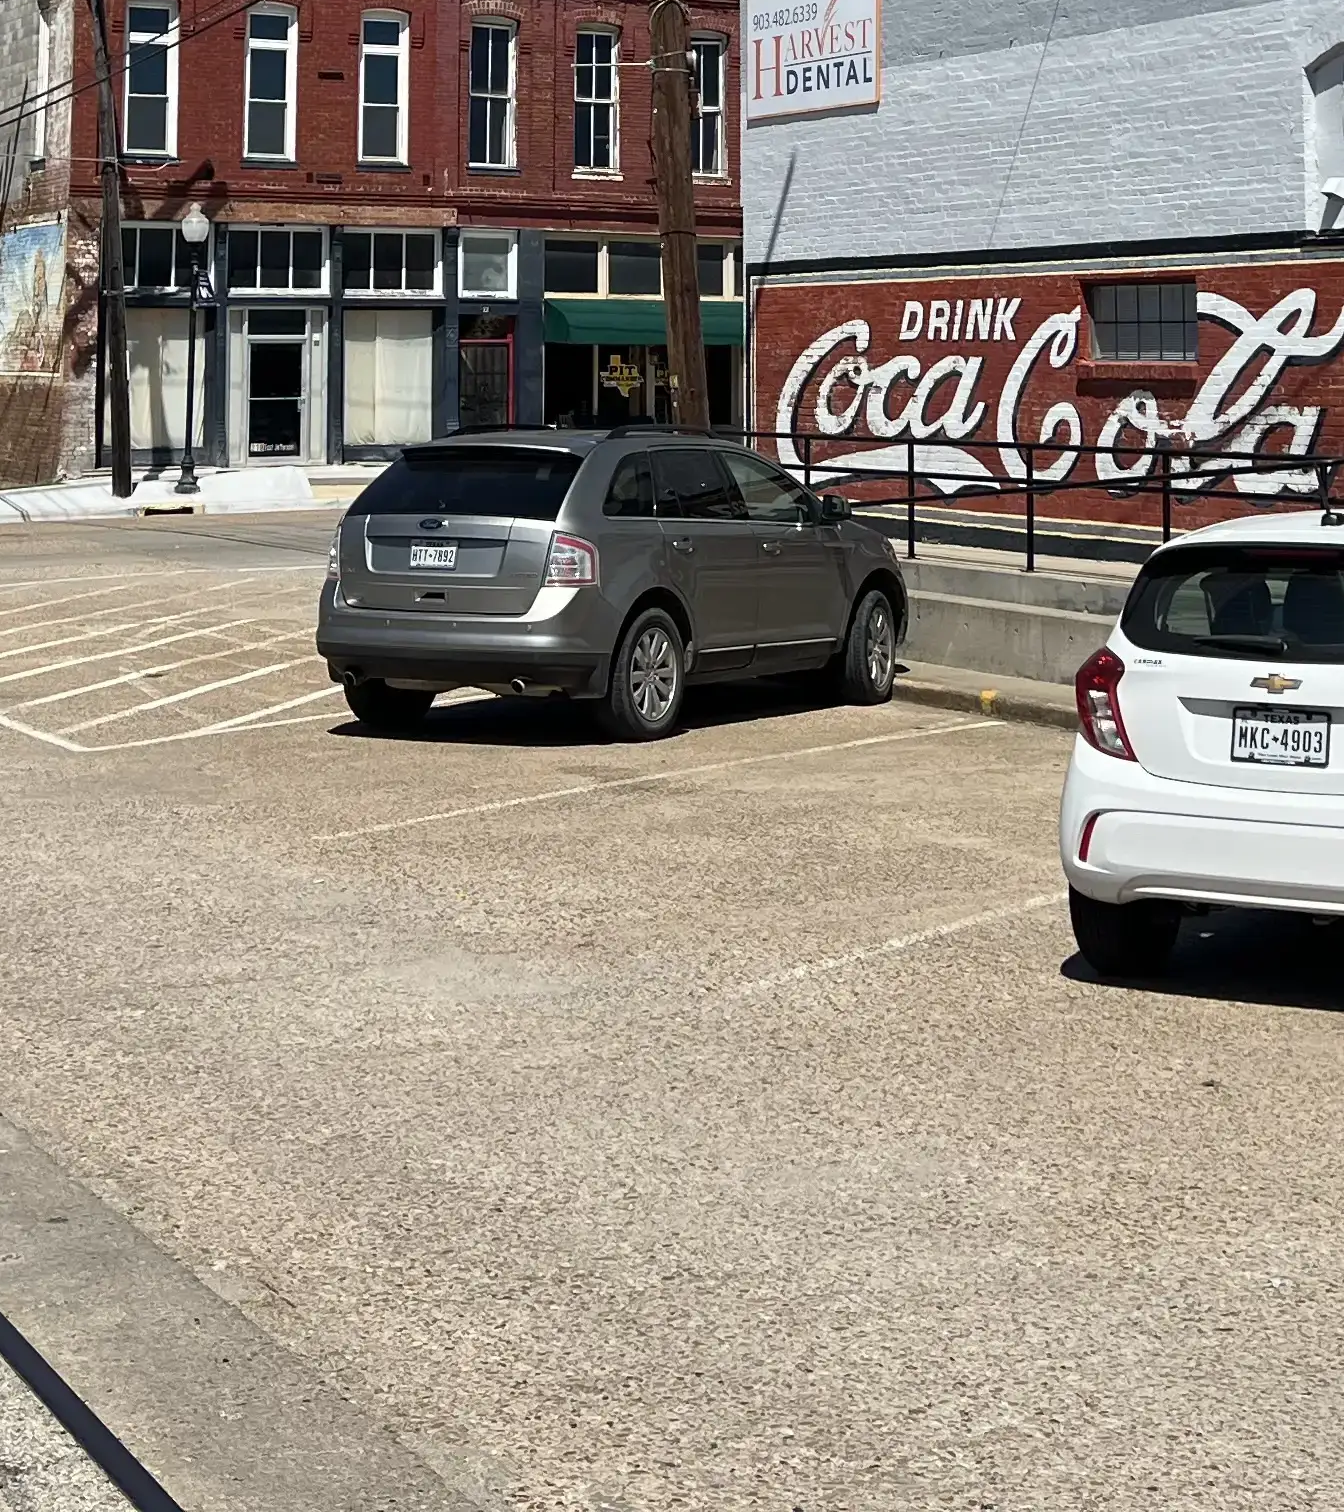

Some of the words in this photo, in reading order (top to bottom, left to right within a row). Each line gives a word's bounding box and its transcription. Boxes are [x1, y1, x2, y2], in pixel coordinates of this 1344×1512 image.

[752, 2, 818, 32] 903.482.6339
[752, 18, 873, 100] HARVEST
[786, 57, 873, 95] DENTAL
[899, 297, 1023, 341] DRINK
[609, 365, 636, 375] PIT
[776, 319, 1001, 498] Coca
[1264, 714, 1300, 725] TEXAS
[1280, 728, 1323, 753] 4903
